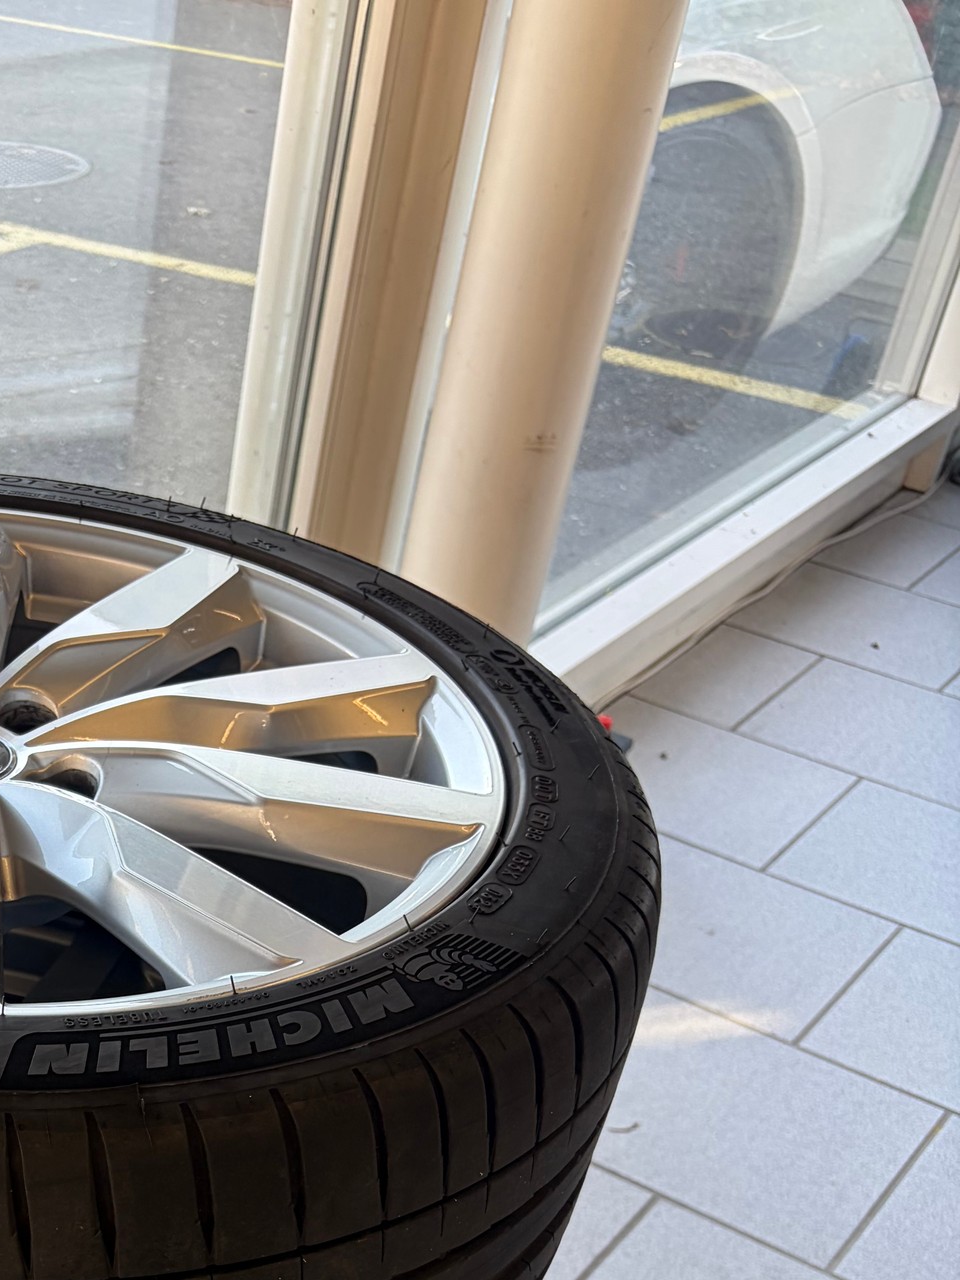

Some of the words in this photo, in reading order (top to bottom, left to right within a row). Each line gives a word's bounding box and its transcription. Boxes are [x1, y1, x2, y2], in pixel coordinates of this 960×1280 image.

[53, 482, 160, 505] SPORT
[27, 976, 418, 1076] MICHELIN
[62, 1009, 168, 1029] TUBELESS
